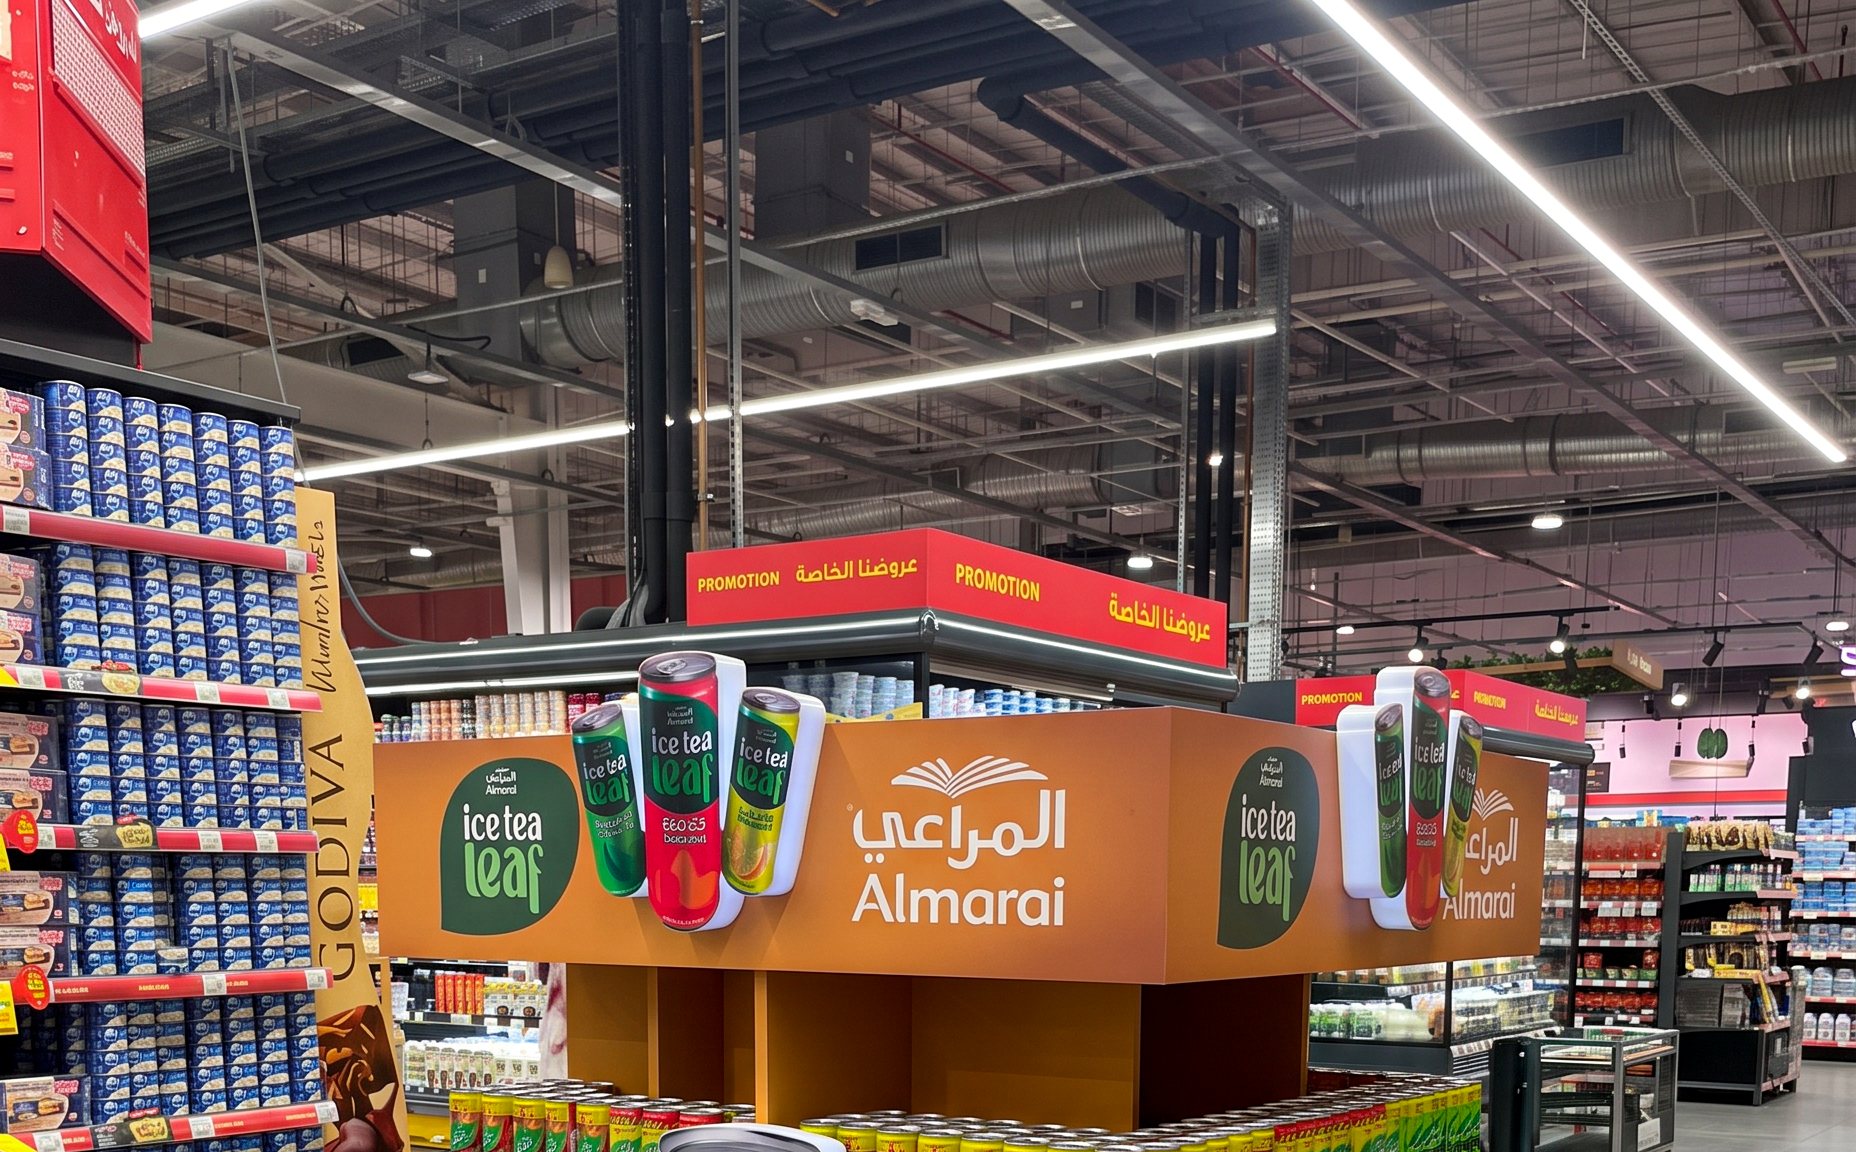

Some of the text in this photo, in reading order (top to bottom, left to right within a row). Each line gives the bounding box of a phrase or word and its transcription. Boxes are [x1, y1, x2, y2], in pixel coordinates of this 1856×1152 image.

[698, 571, 780, 593] PROMOTION
[795, 557, 918, 584] عروضنا الخاصة
[955, 562, 1040, 602] PROMOTION
[1108, 592, 1211, 643] عروضنا الخاصة
[1301, 692, 1363, 706] PROMOTION
[651, 727, 713, 756] ice tea
[738, 736, 763, 764] ice
[583, 761, 605, 781] ice
[652, 753, 714, 803] leaf
[735, 756, 787, 805] leaf
[462, 802, 543, 841] ice tea
[852, 788, 1067, 870] المراعي
[1240, 792, 1296, 842] ice tea
[308, 733, 357, 982] GODIVA
[463, 841, 544, 915] leaf
[851, 872, 1066, 927] Almarai
[1238, 839, 1297, 922] leaf
[1442, 879, 1516, 921] Almarai
